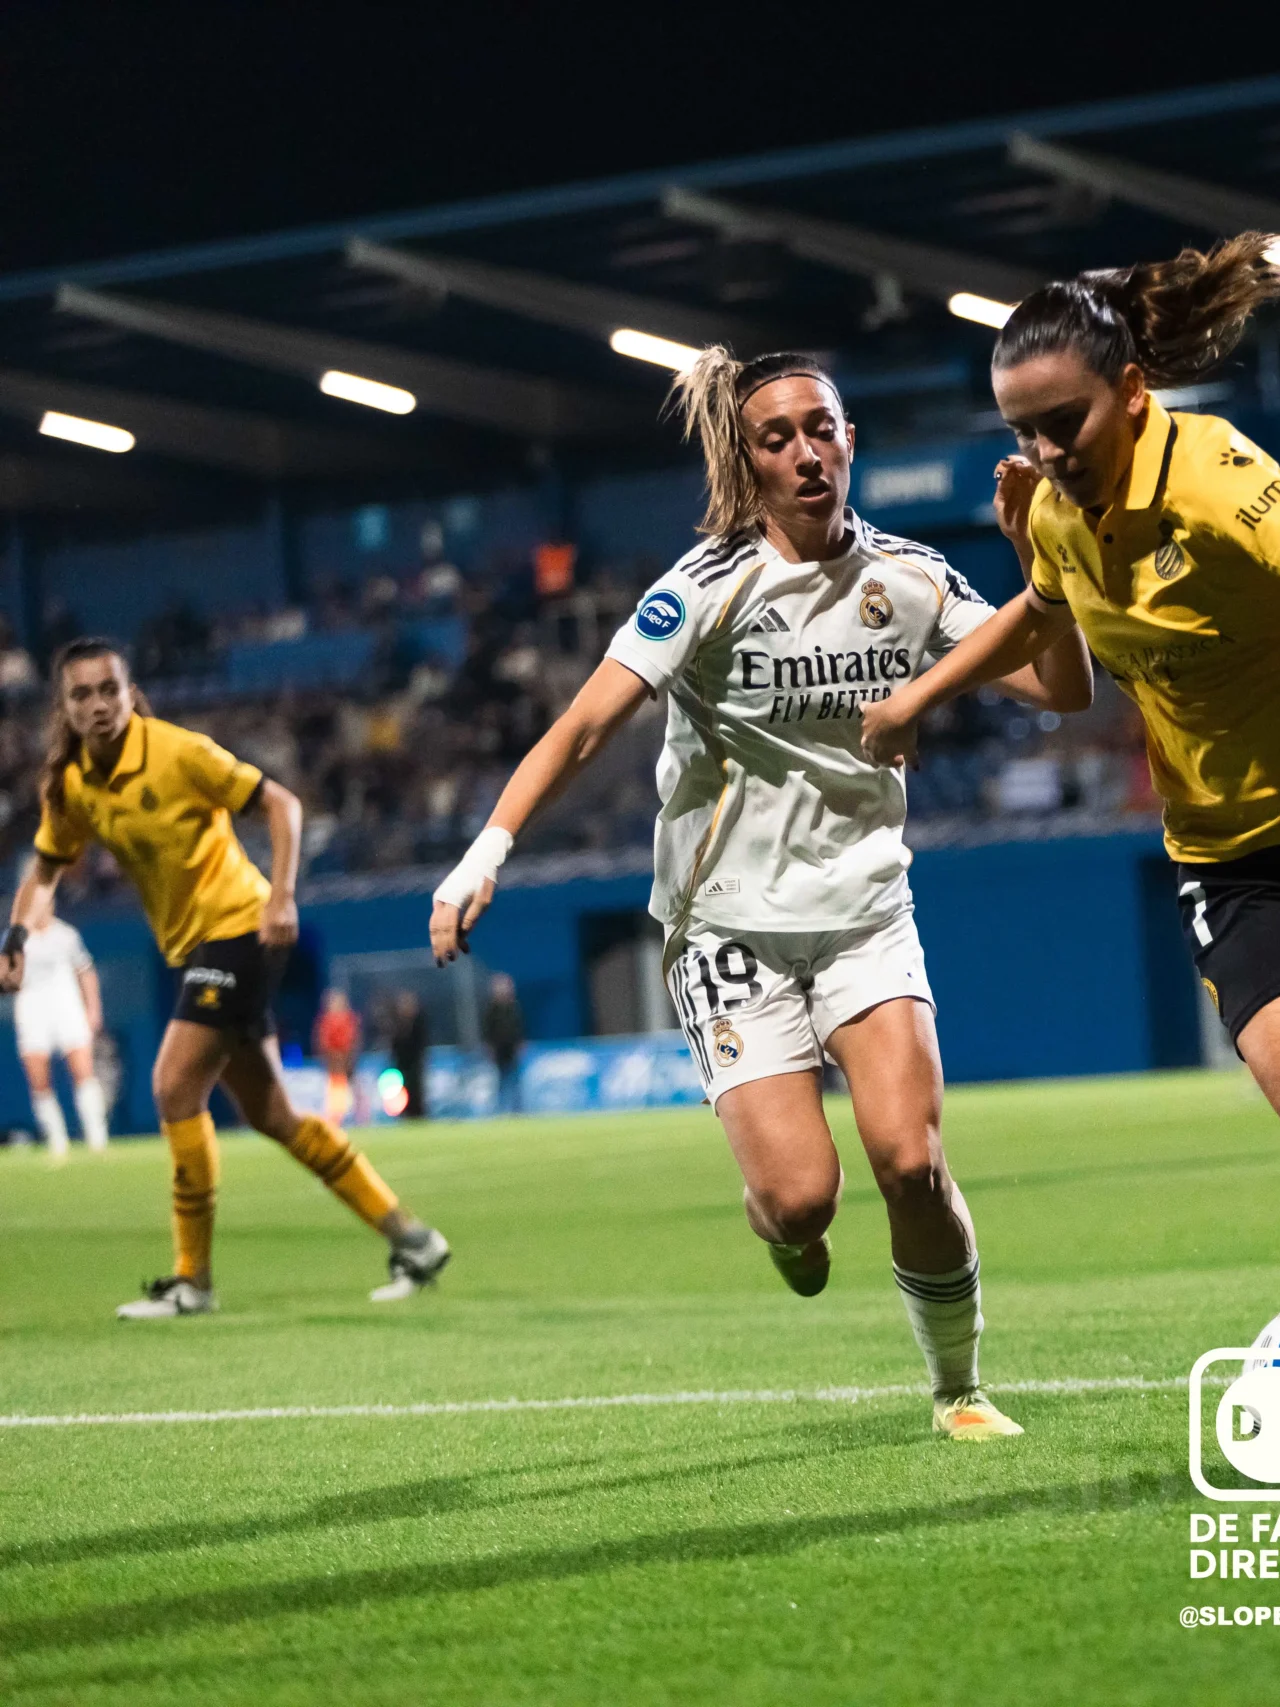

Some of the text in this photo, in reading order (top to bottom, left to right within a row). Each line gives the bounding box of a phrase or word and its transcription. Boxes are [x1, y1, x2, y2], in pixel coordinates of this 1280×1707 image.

[643, 609, 671, 628] Liga F
[740, 645, 911, 690] Emirates
[768, 692, 812, 724] FLY
[693, 942, 763, 1014] 19
